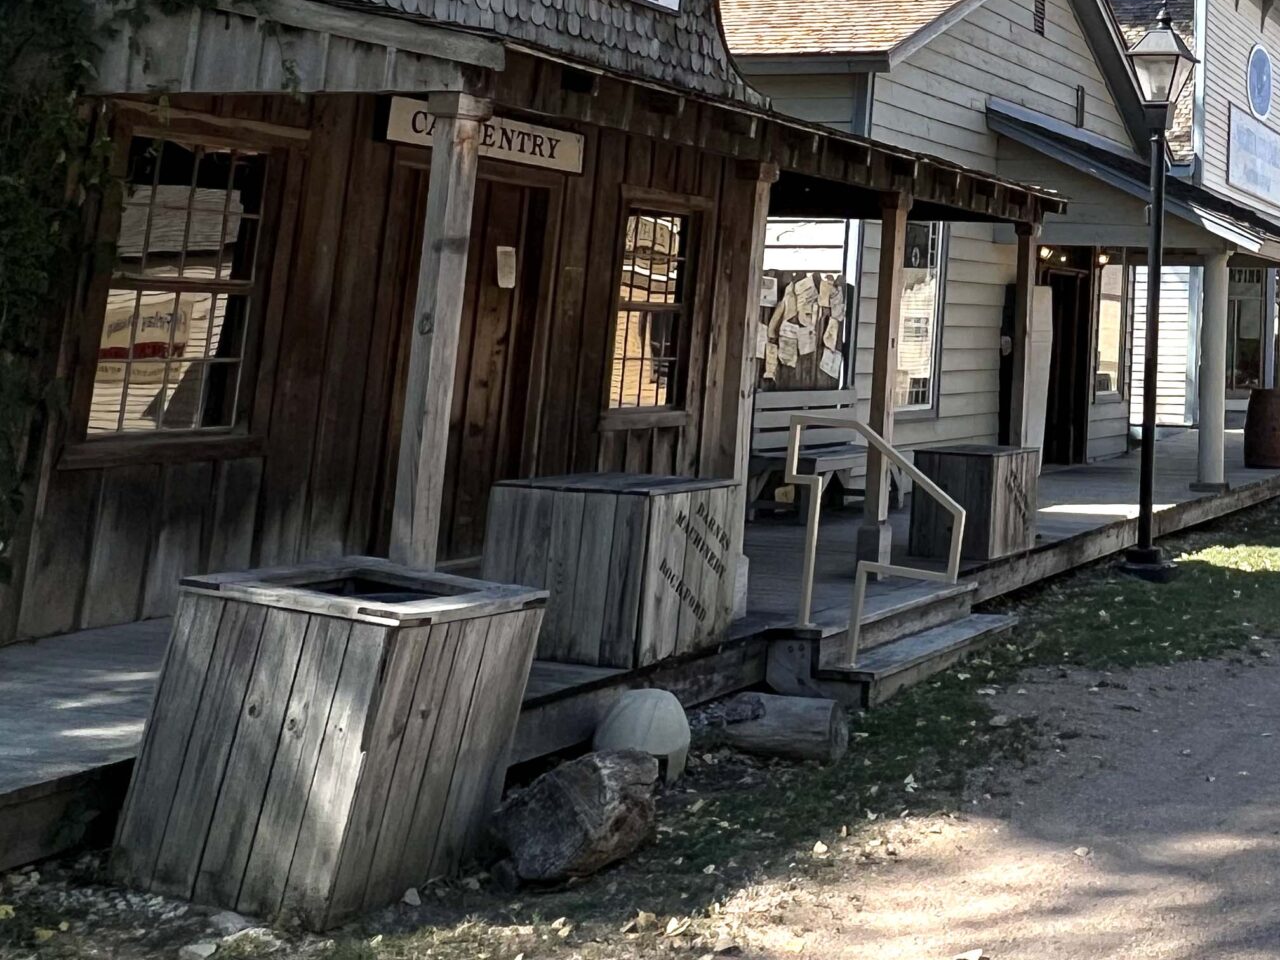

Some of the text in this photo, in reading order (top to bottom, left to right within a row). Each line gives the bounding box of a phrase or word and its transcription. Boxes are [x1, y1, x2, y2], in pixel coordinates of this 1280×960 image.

[411, 111, 561, 159] CAENTRY
[675, 510, 726, 579] MACHINERY
[696, 502, 730, 551] BARNES
[659, 557, 707, 622] ROCKFORD
